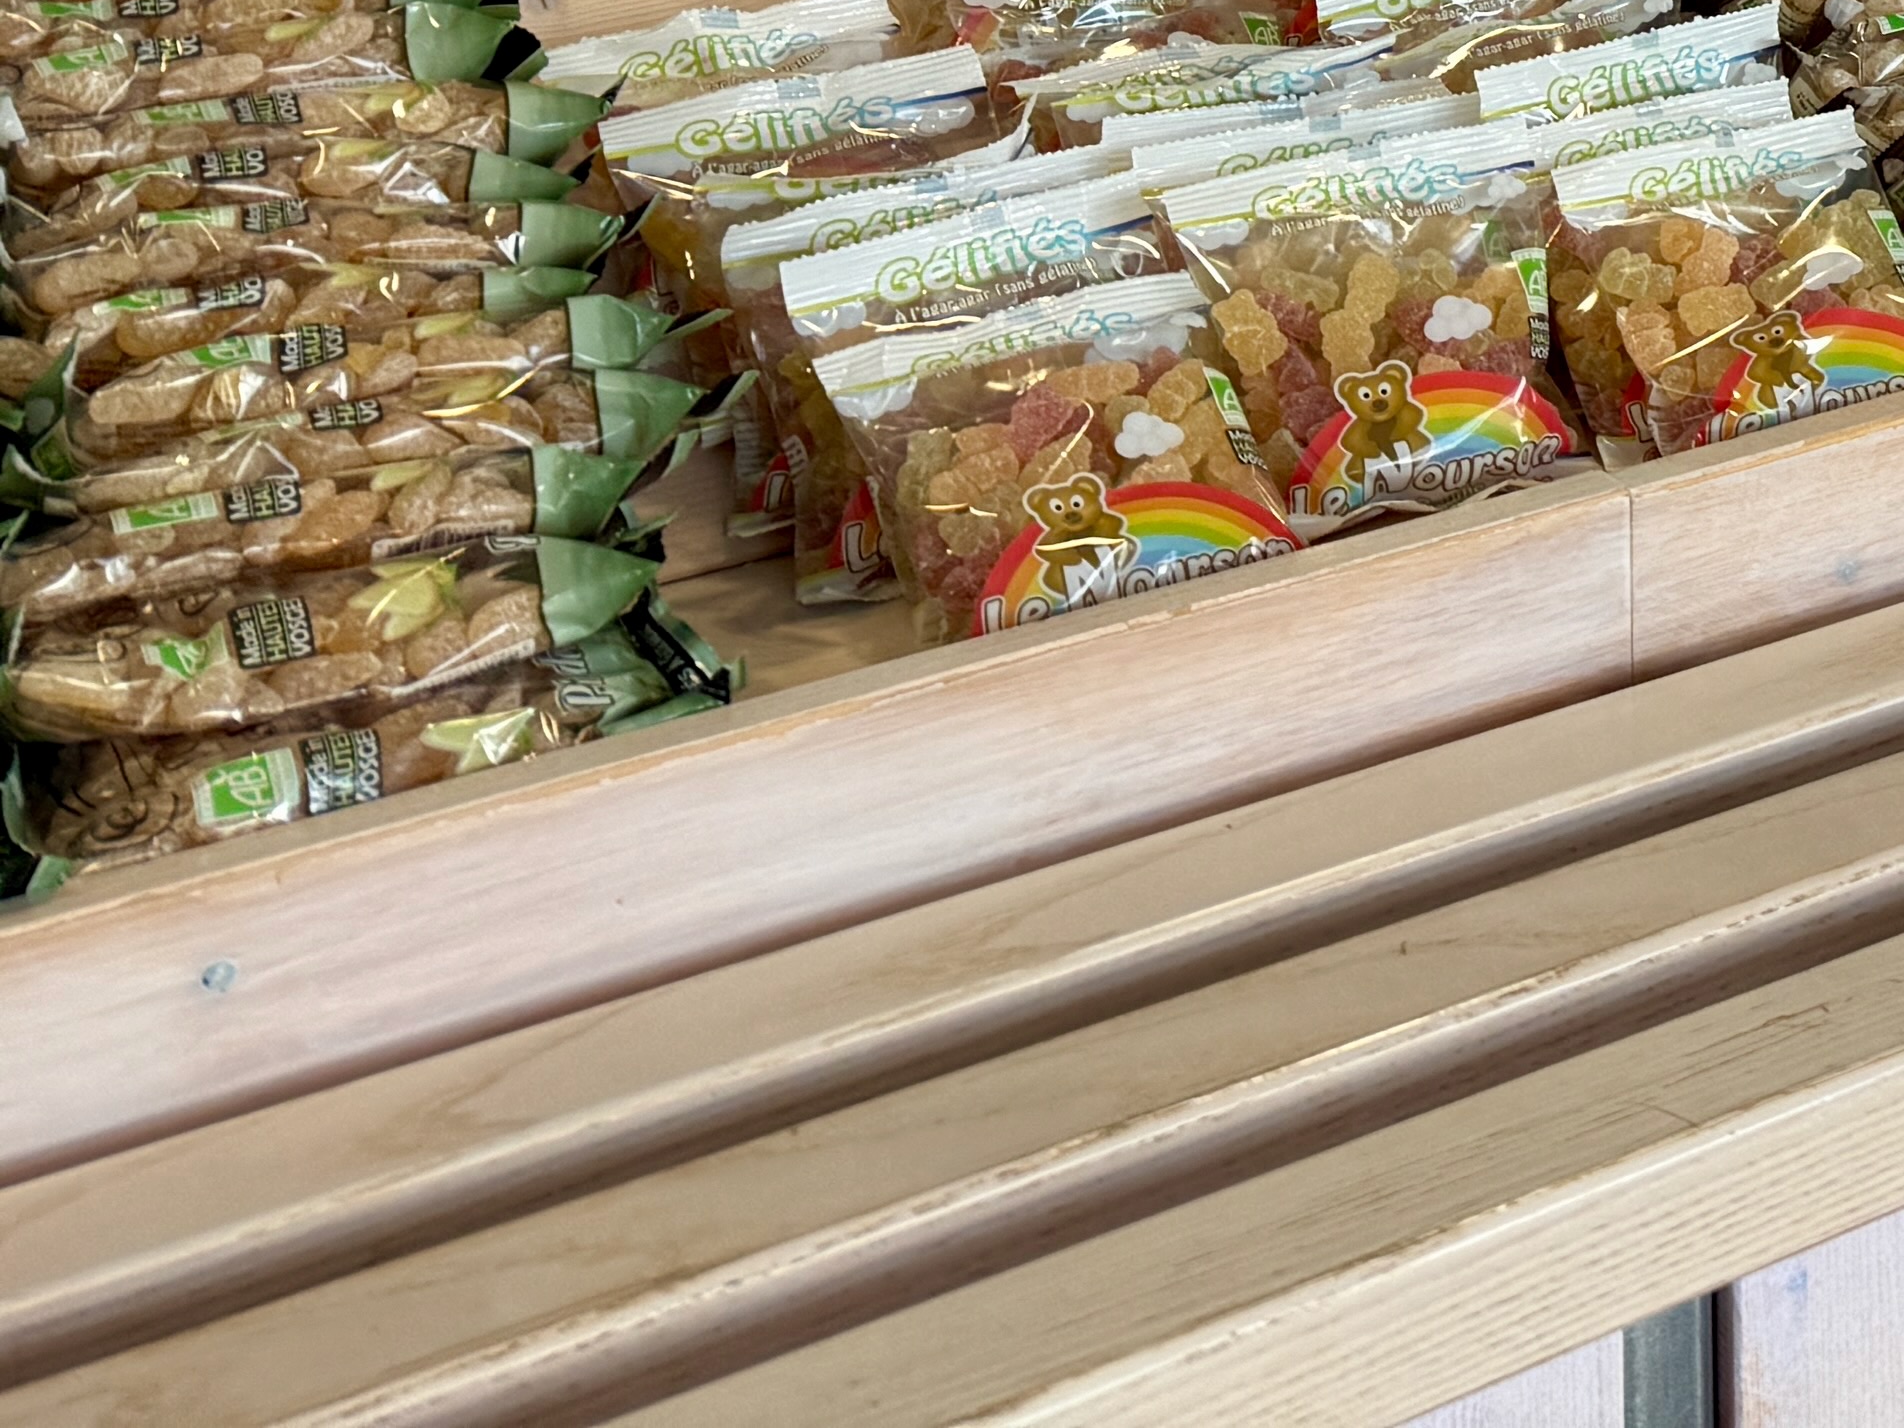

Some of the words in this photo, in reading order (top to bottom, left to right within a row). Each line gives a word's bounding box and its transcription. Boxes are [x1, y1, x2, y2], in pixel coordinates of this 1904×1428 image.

[1546, 45, 1727, 121] Gélifiés
[674, 96, 896, 159] Gélifiés
[874, 216, 1089, 305] Gélifiés
[1360, 432, 1560, 503] Nourson
